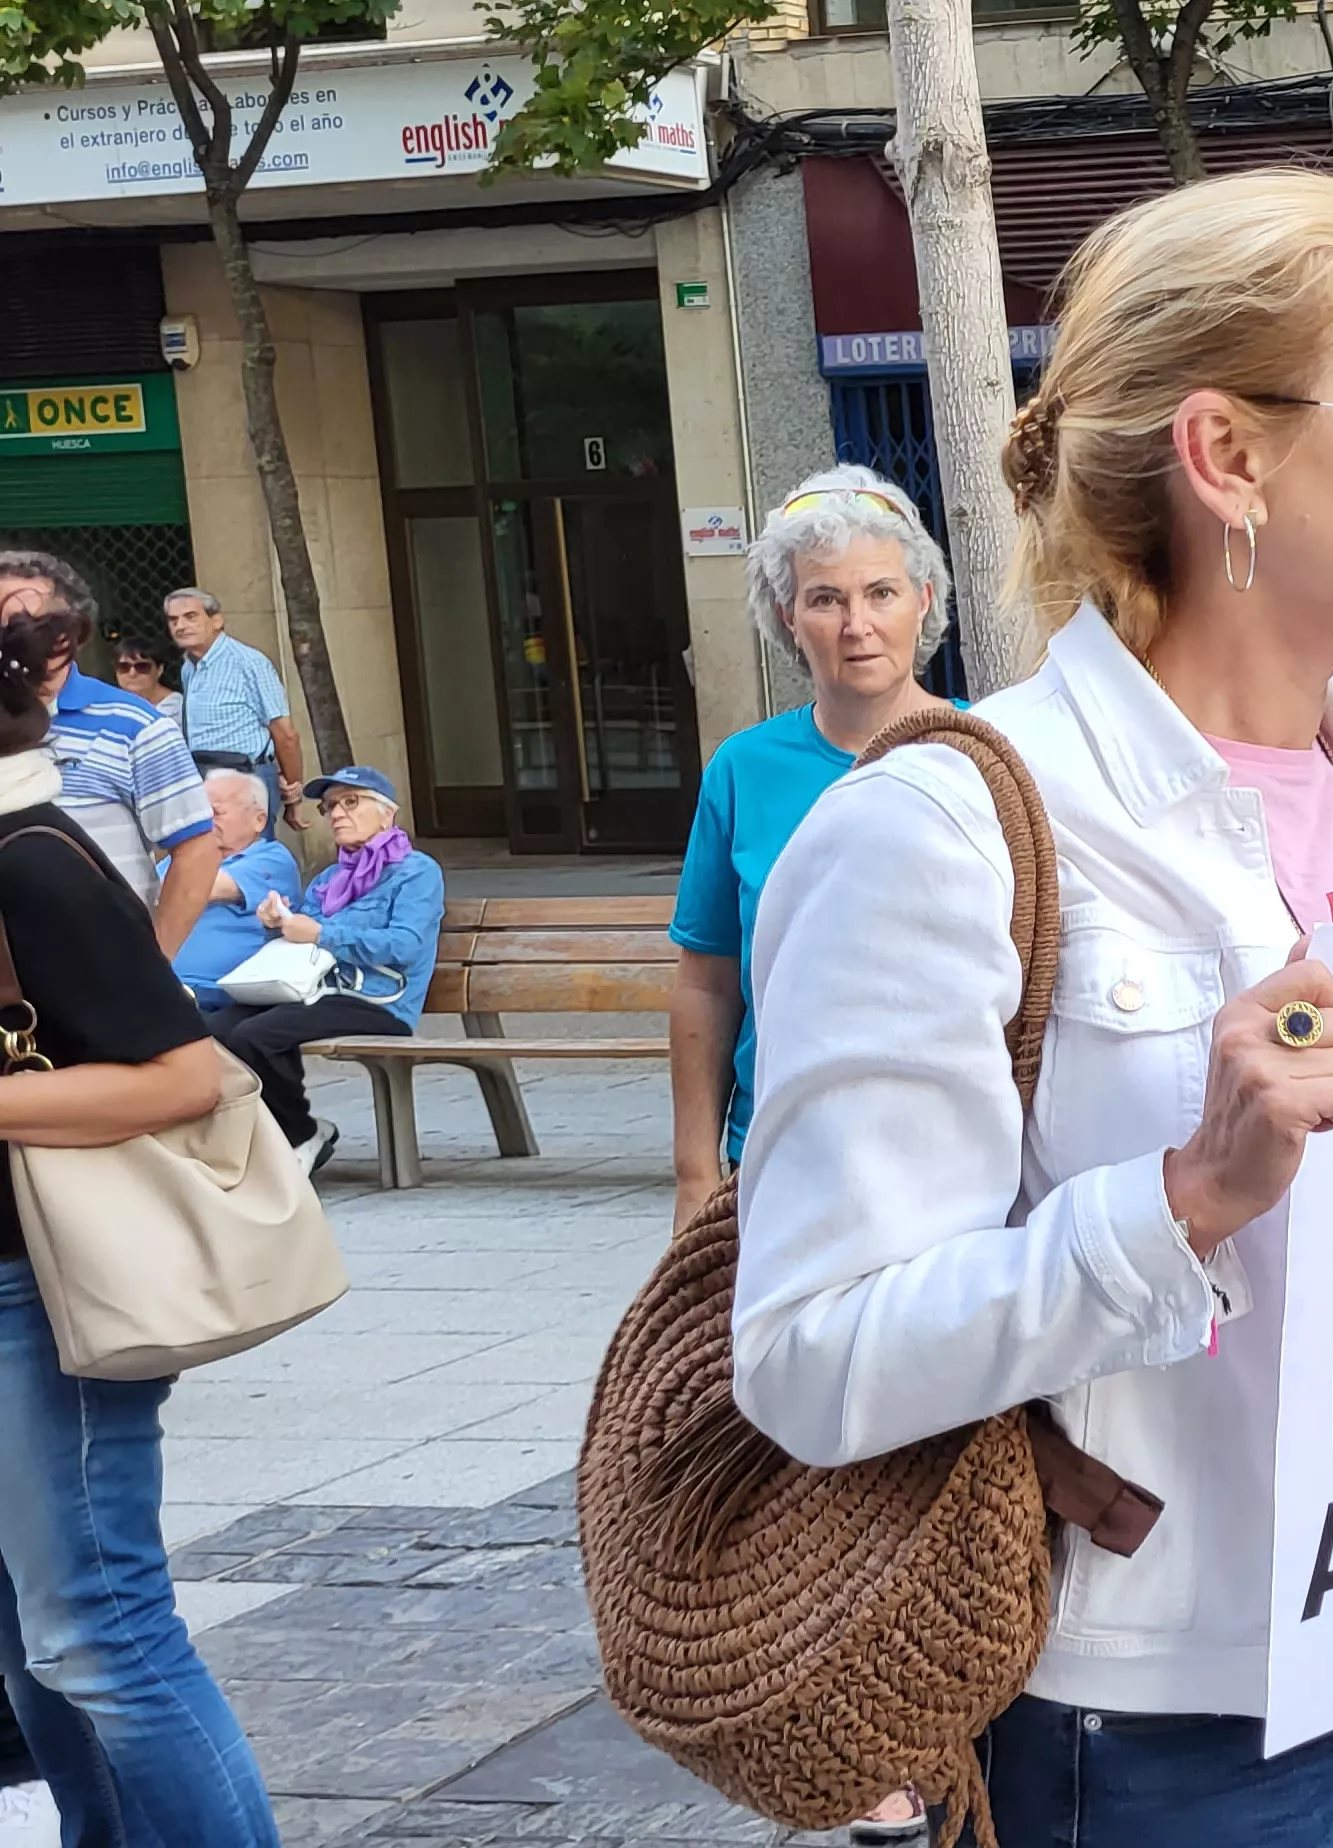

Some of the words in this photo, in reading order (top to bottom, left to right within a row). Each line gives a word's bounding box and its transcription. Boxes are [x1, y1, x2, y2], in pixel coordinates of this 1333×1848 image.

[57, 104, 117, 122] Cursos
[123, 103, 132, 122] y
[137, 97, 212, 116] Práca
[315, 88, 337, 103] en
[60, 133, 75, 149] el
[81, 126, 166, 148] extranjero
[244, 120, 284, 136] too
[290, 114, 305, 132] el
[311, 112, 343, 130] año
[402, 112, 489, 168] english
[658, 122, 695, 148] maths
[37, 394, 134, 426] ONCE
[52, 438, 91, 449] HUESCA
[588, 440, 602, 466] 6
